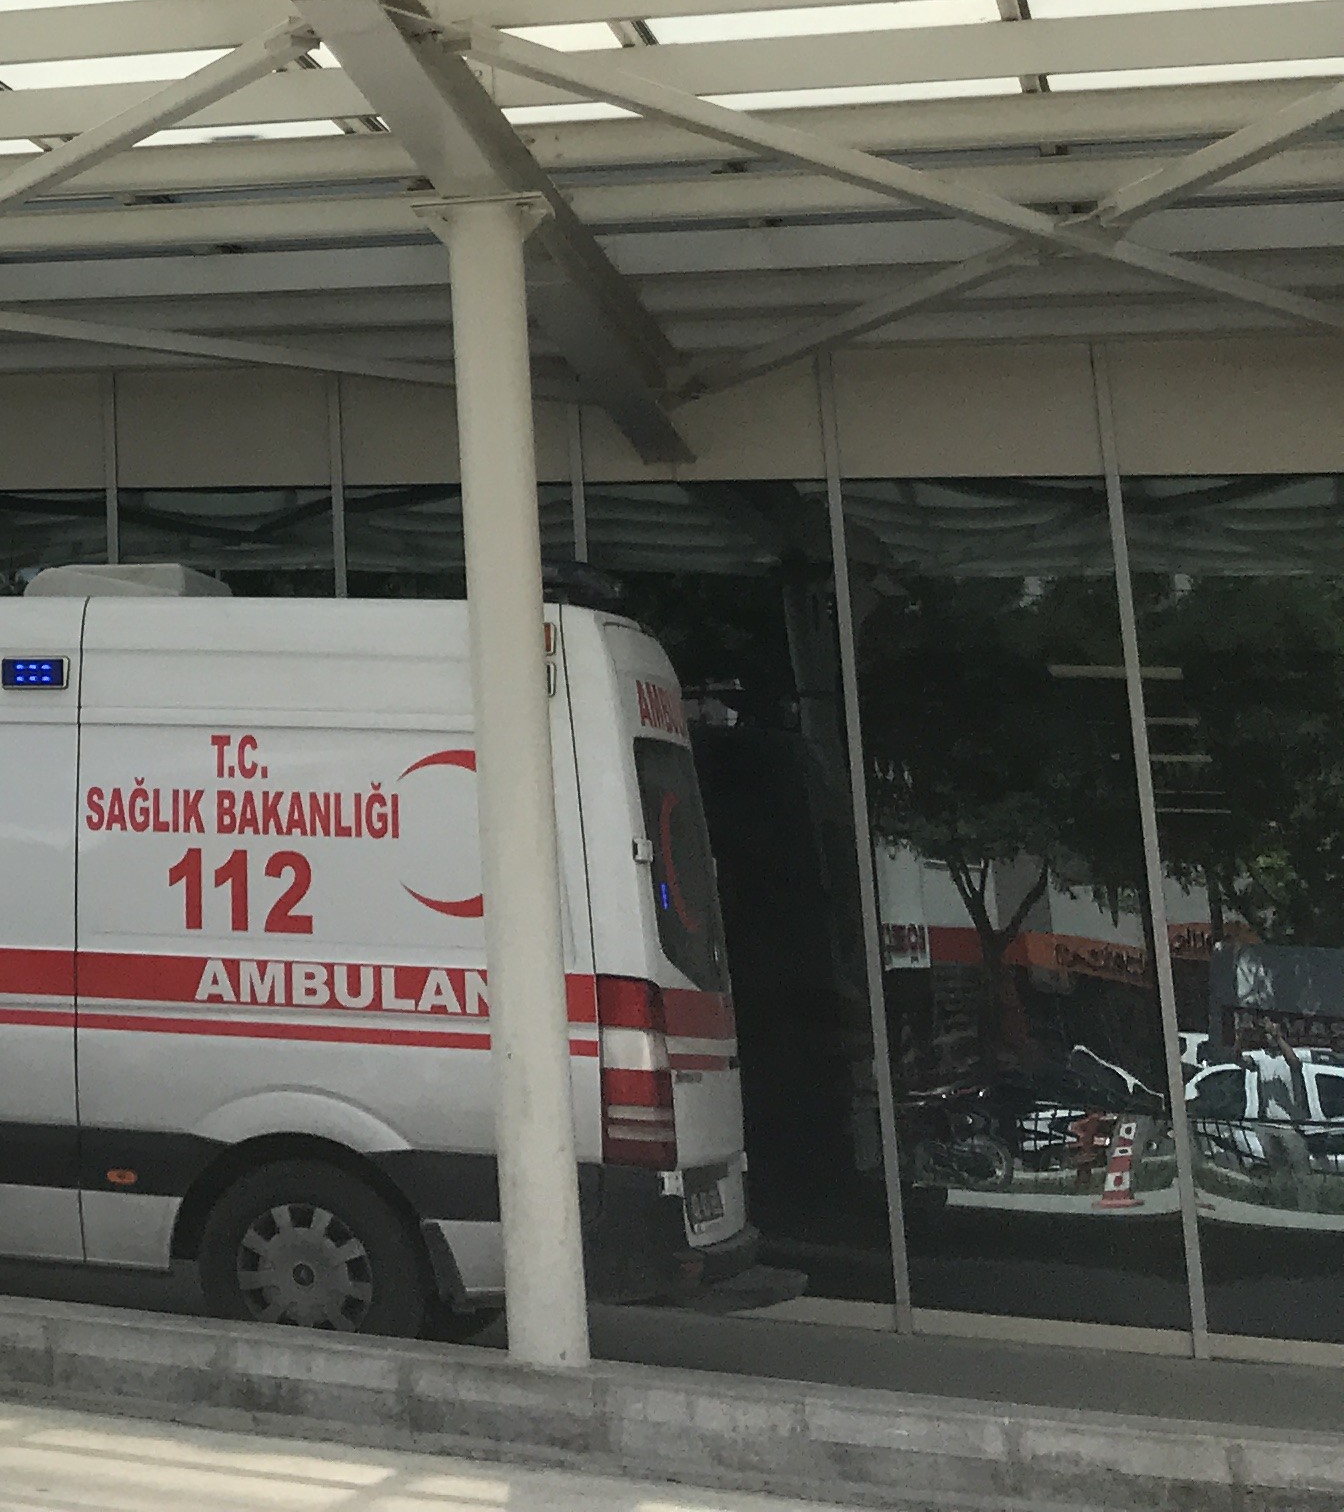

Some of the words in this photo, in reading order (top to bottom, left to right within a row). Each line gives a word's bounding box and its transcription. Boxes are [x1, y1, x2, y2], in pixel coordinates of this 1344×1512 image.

[210, 734, 269, 779] T.C.
[85, 777, 206, 834] SAĞLIK
[216, 781, 400, 839] BAKANLIĞI
[168, 847, 314, 935] 112
[194, 959, 490, 1015] AMBULAN
